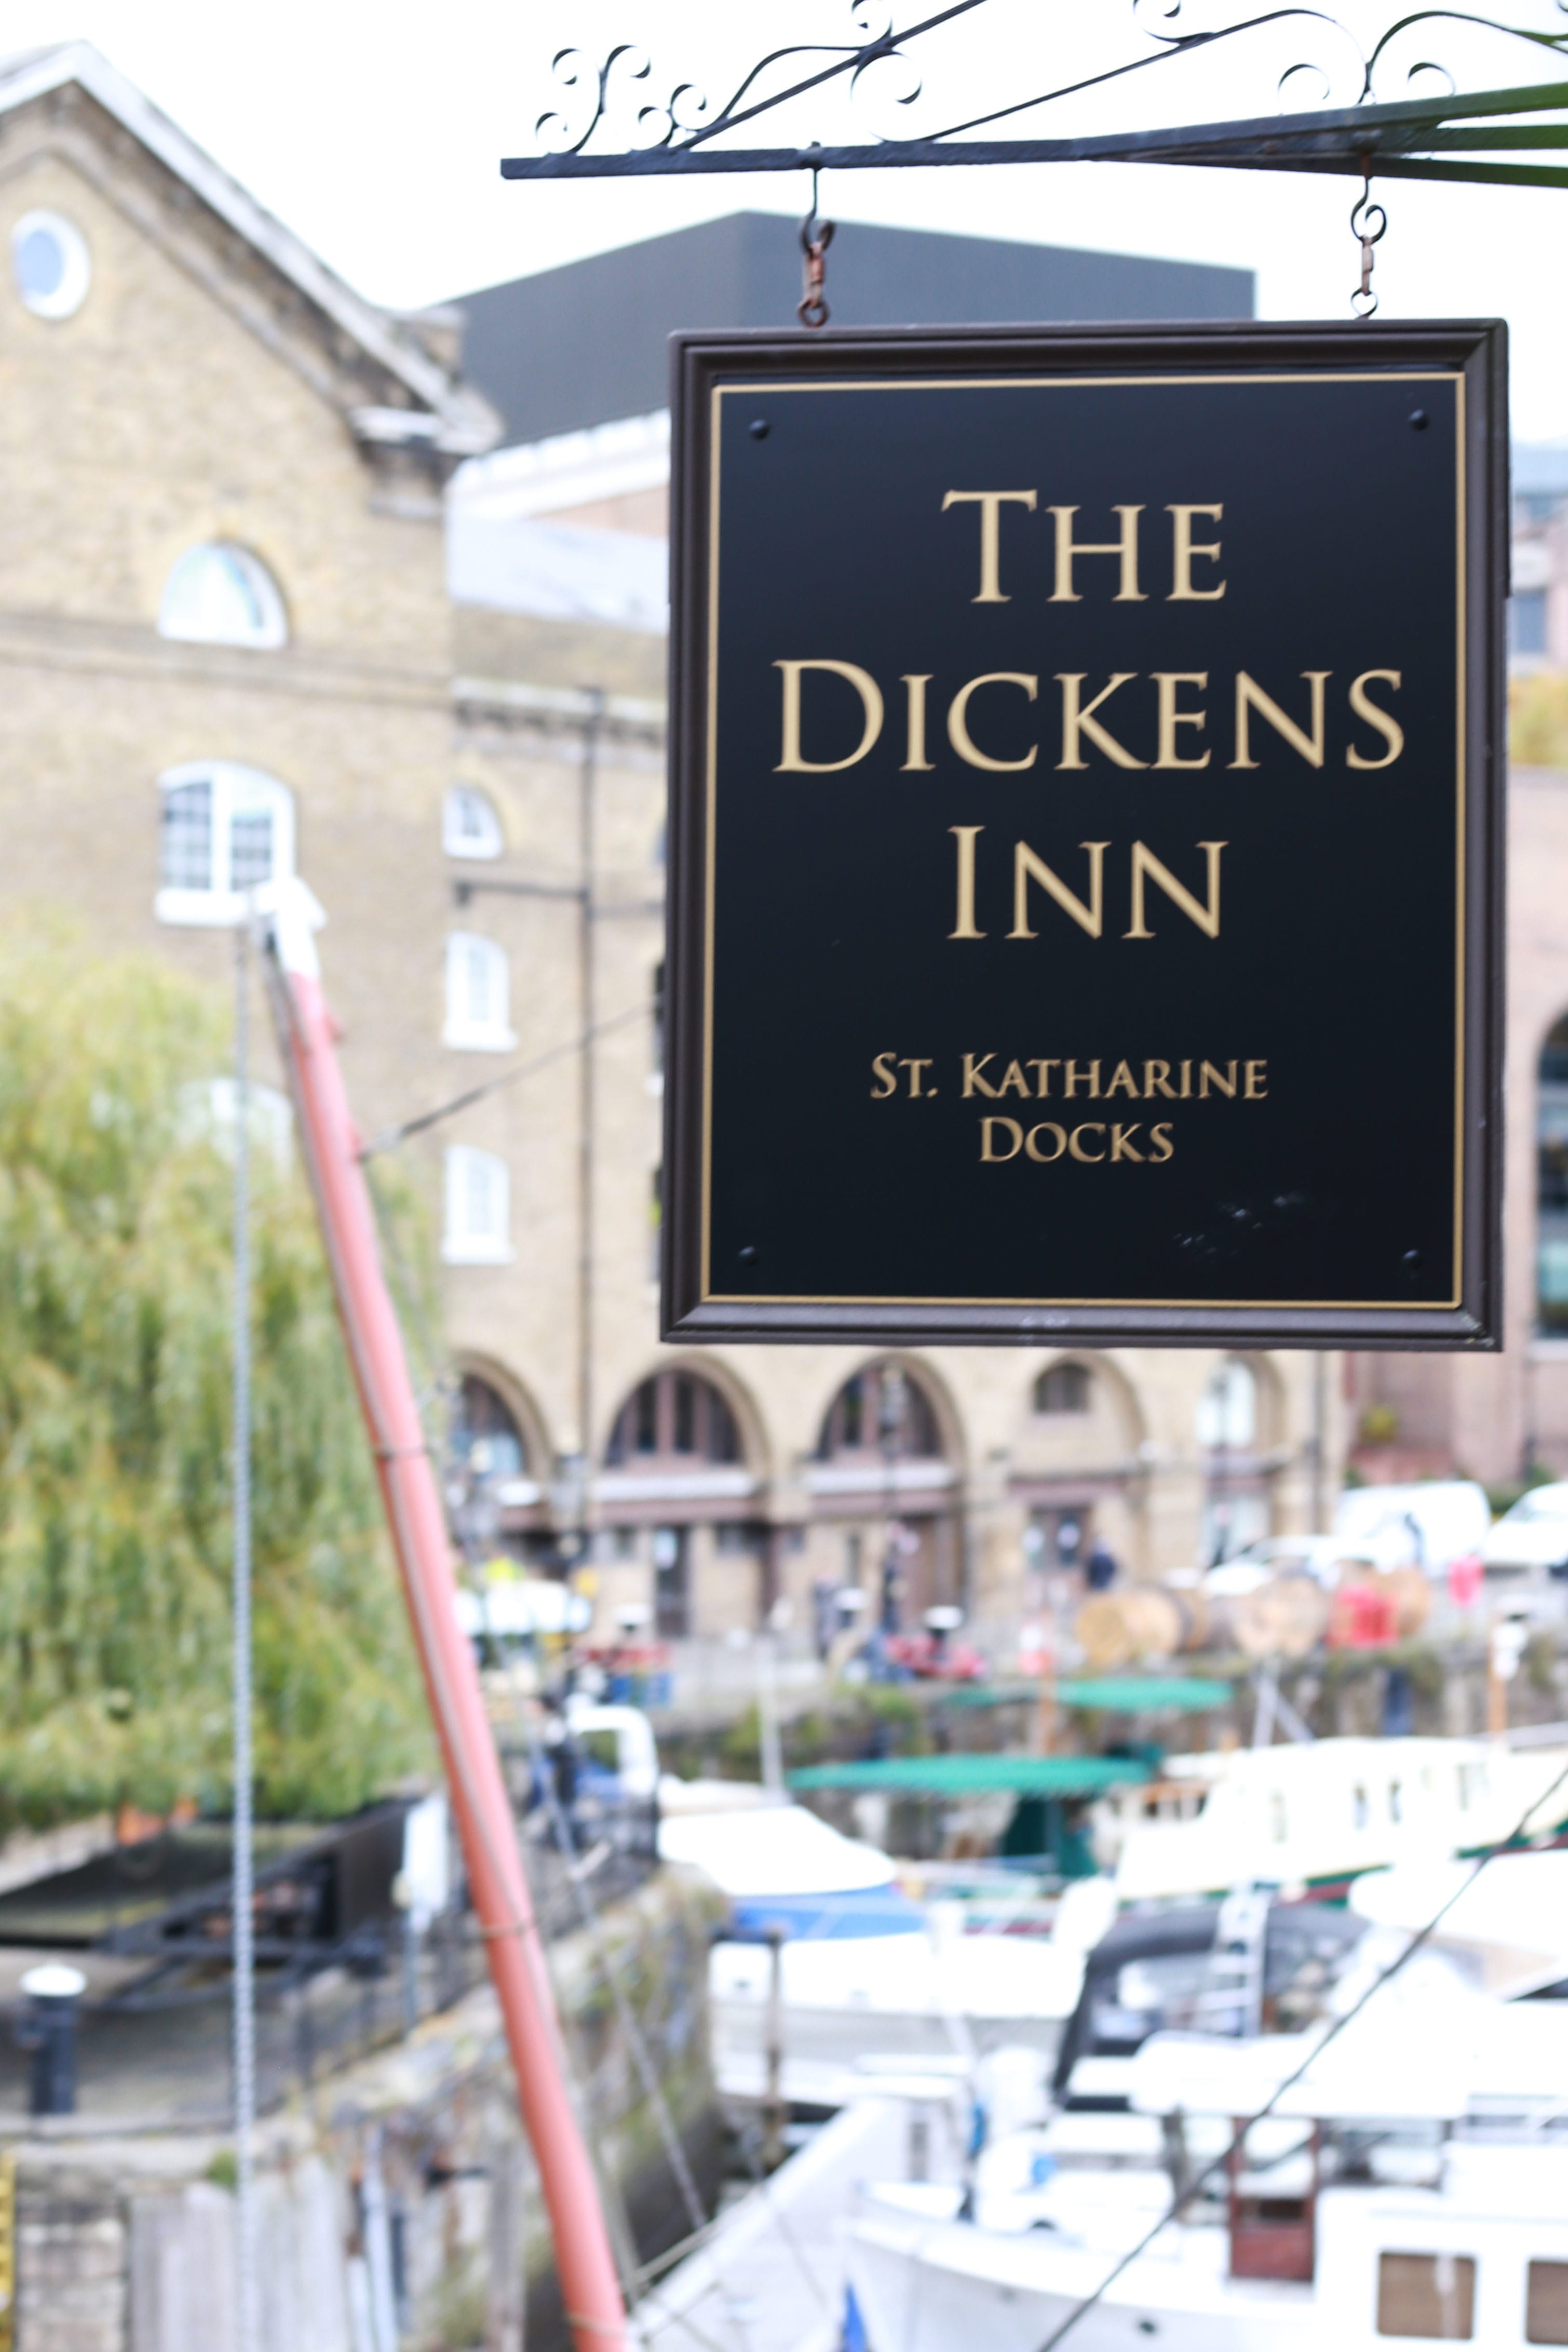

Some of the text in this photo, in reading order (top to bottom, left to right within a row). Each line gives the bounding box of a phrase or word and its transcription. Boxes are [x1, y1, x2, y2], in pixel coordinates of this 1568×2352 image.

[941, 488, 1227, 603] THE
[772, 658, 1404, 773] DICKENS
[948, 826, 1228, 939] INN
[871, 1052, 1268, 1099] ST. KATHARINE
[979, 1116, 1174, 1163] DOCKS
